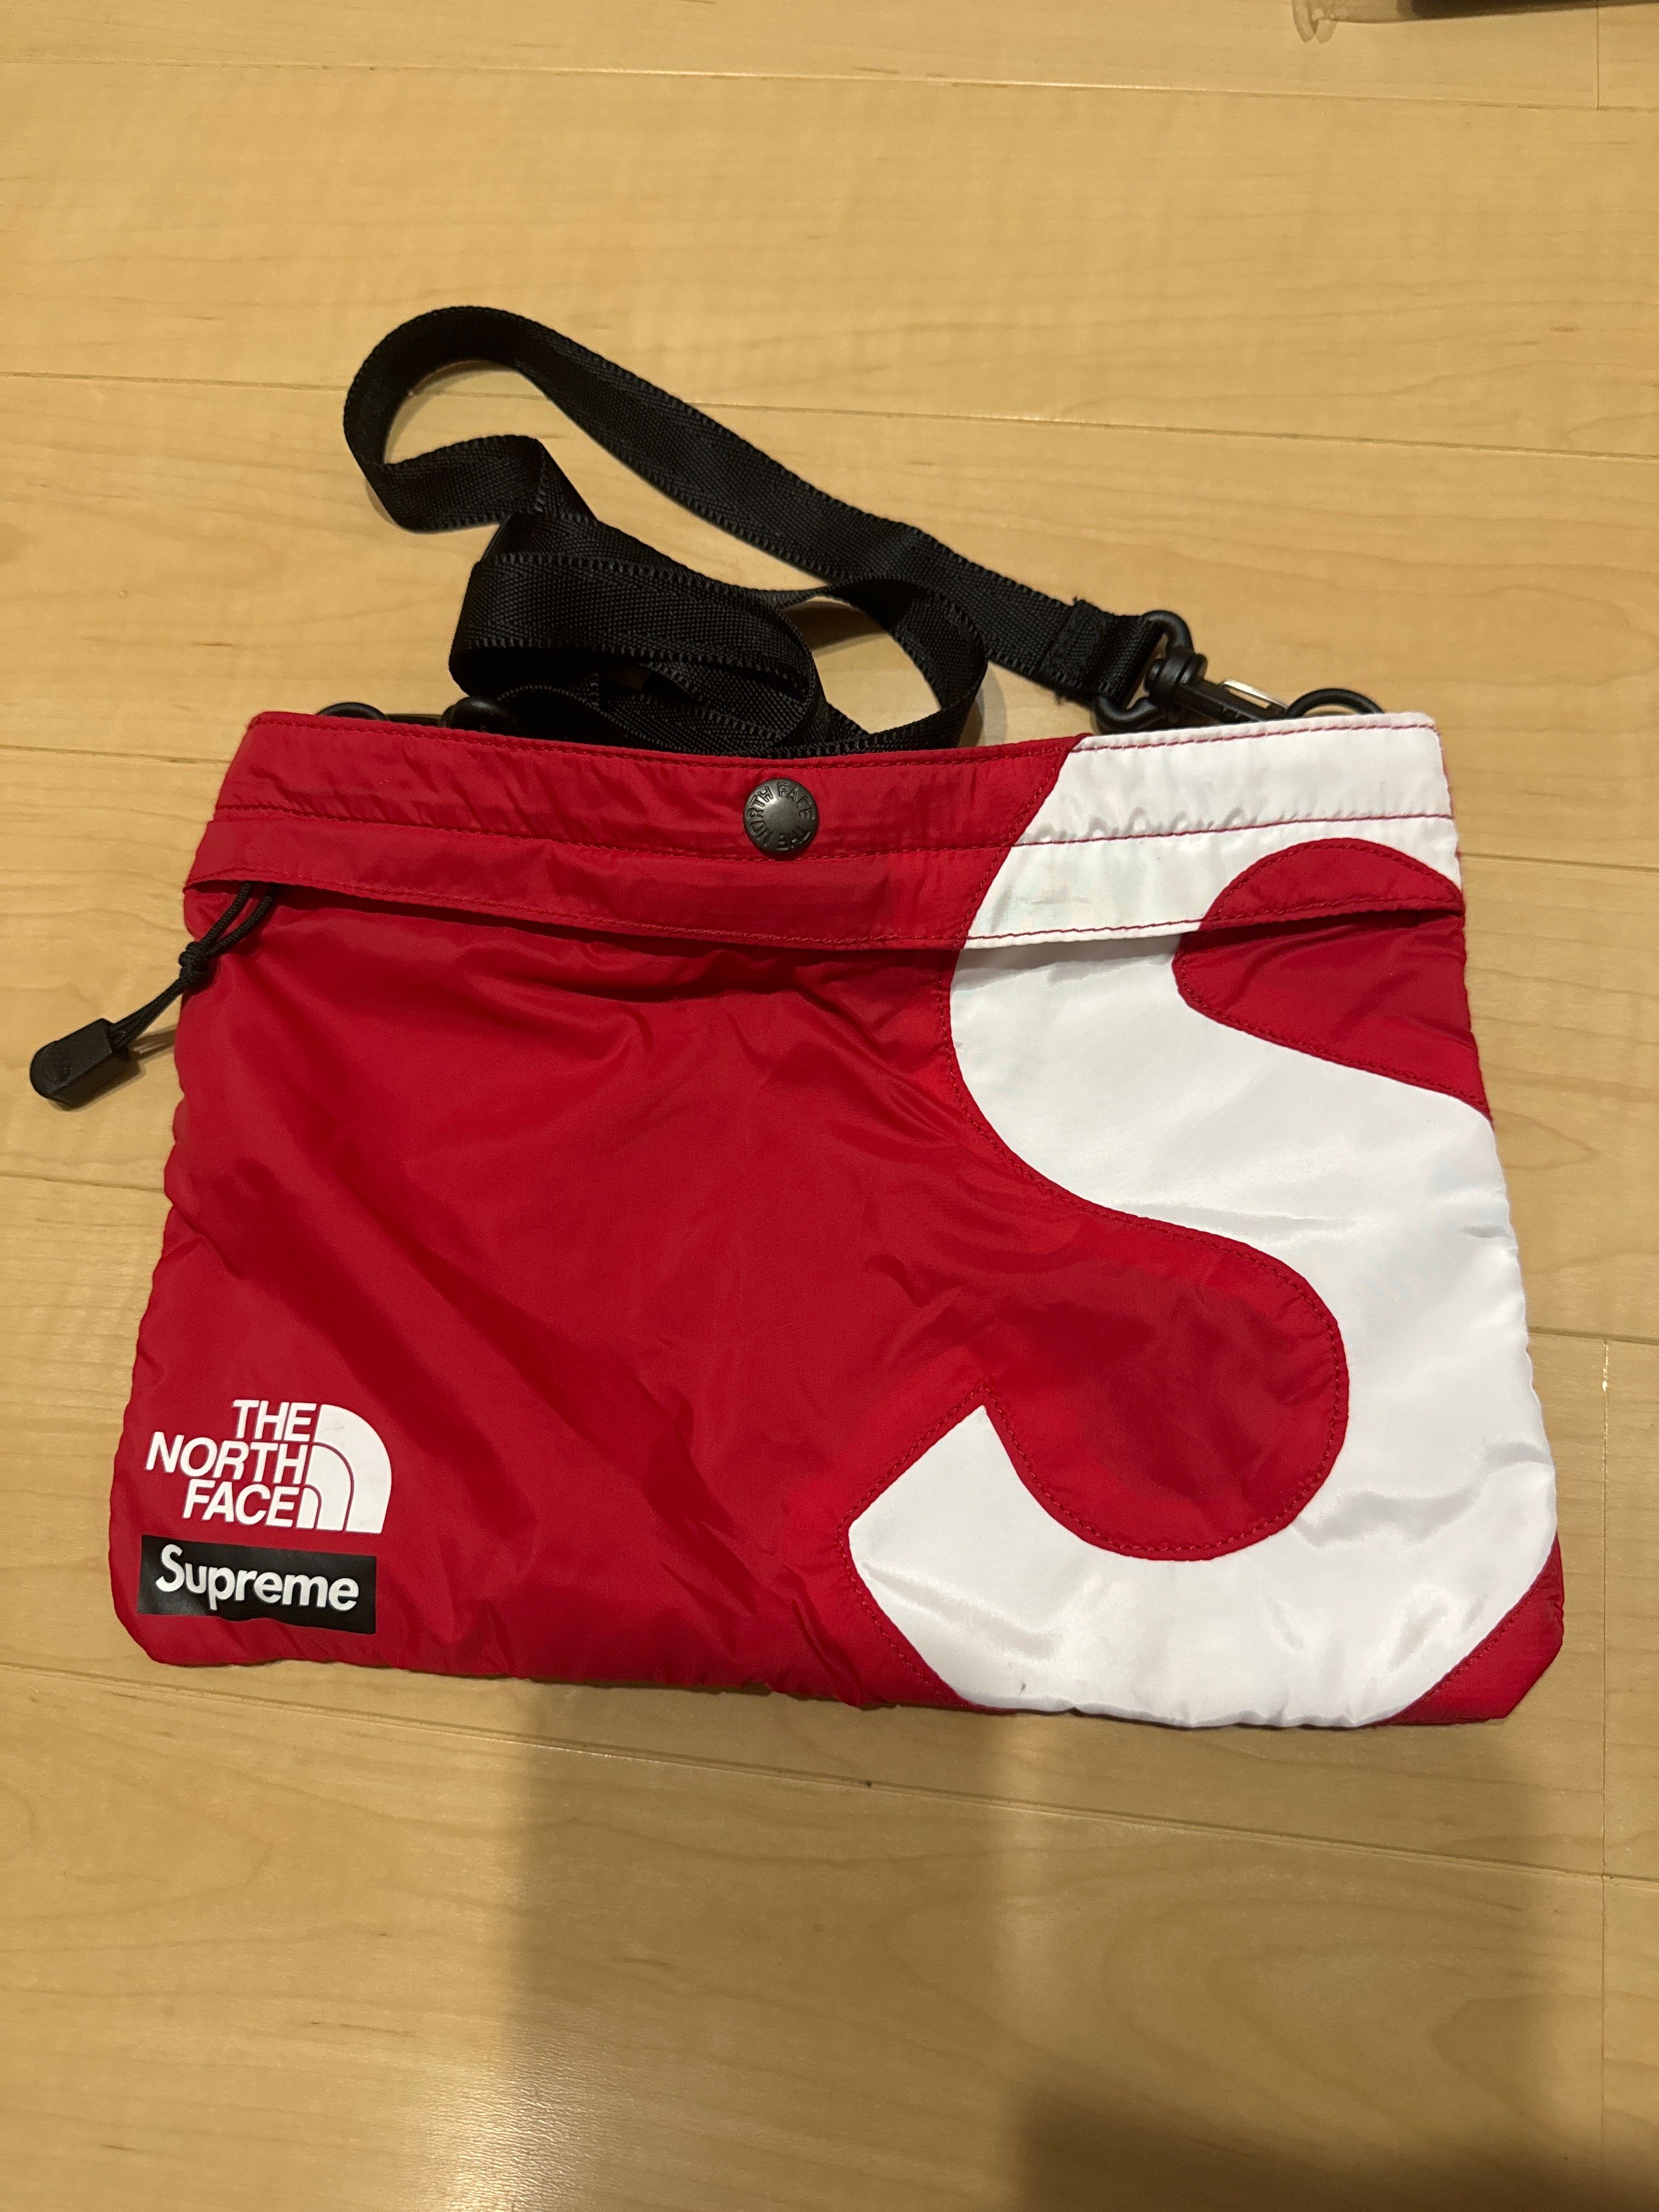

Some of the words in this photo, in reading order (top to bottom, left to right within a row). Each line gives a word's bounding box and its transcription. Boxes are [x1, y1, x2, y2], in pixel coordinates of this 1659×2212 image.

[746, 785, 775, 847] NORTH
[777, 782, 816, 820] FACE
[232, 1399, 317, 1442] THE
[145, 1431, 308, 1485] NORTH
[182, 1479, 298, 1528] FACE
[155, 1544, 359, 1611] Supreme
